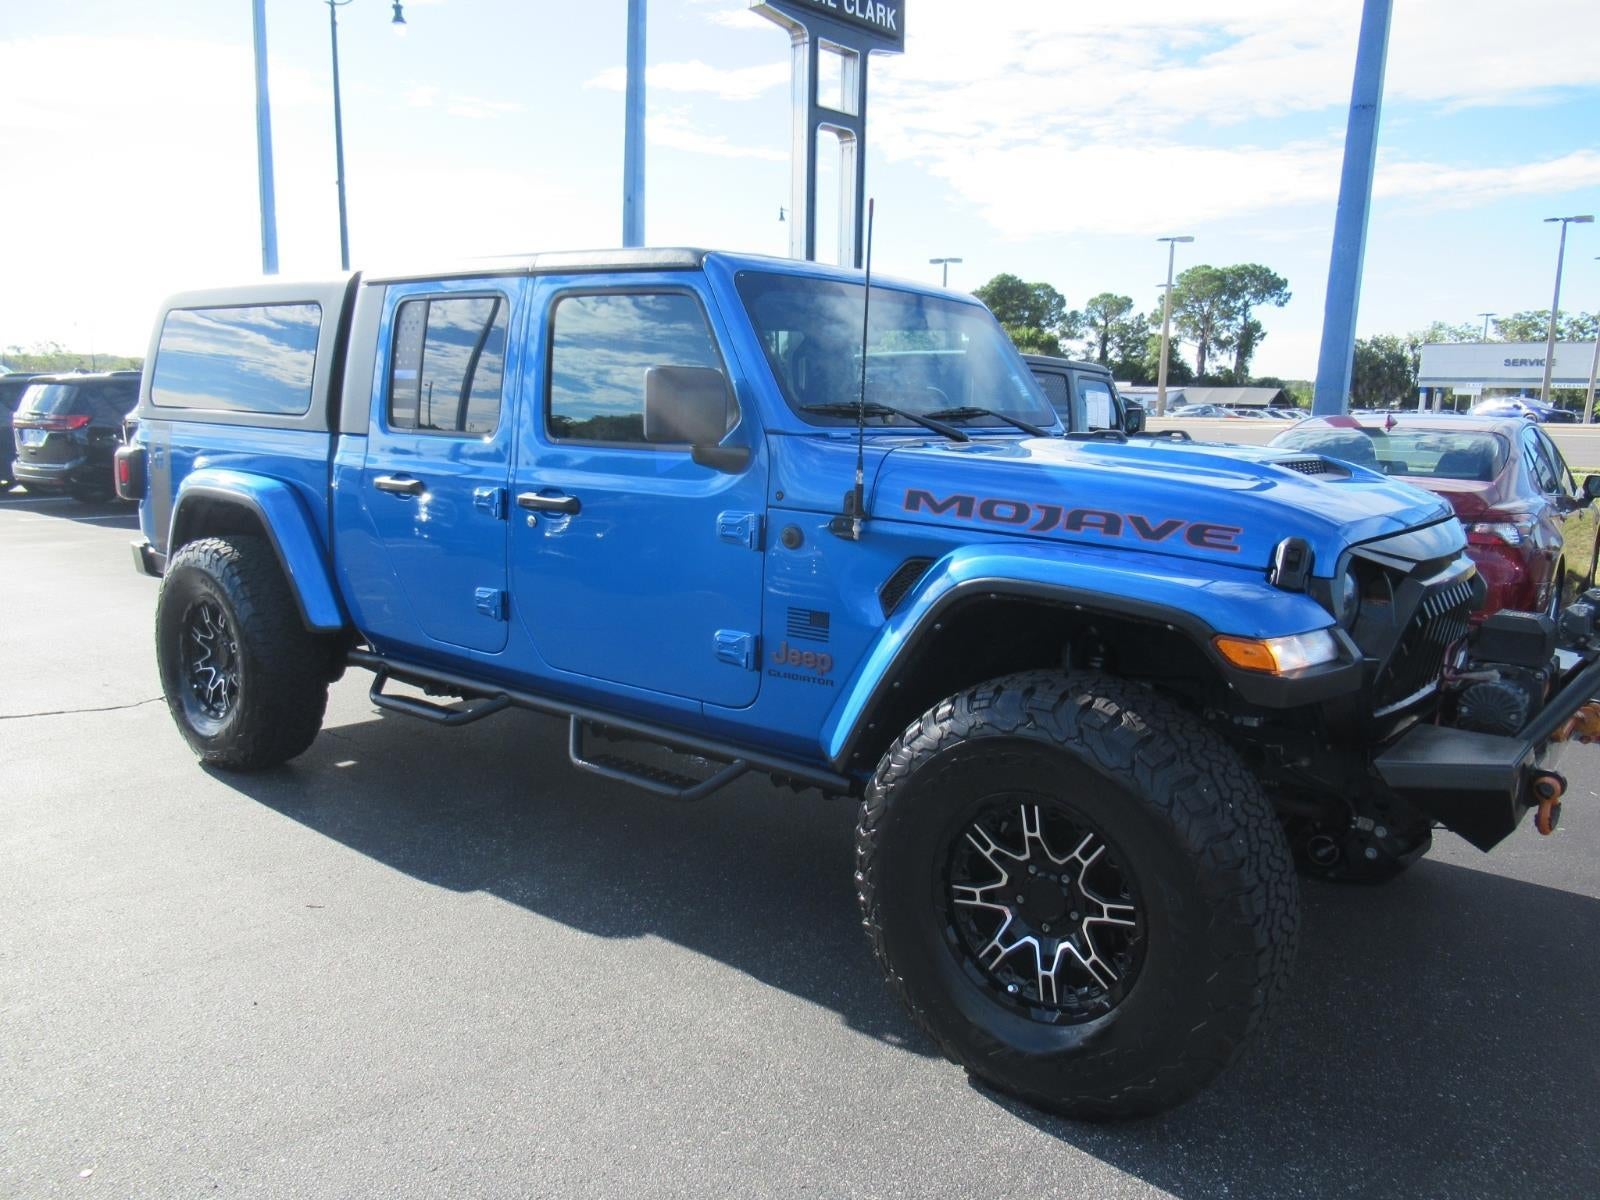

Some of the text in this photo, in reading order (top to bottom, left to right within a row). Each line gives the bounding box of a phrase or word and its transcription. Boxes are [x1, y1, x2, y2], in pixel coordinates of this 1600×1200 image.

[844, 0, 897, 31] CLARK
[904, 488, 1243, 552] MOJAVE
[771, 640, 833, 677] Jeep
[767, 669, 834, 687] GLADIATOR
